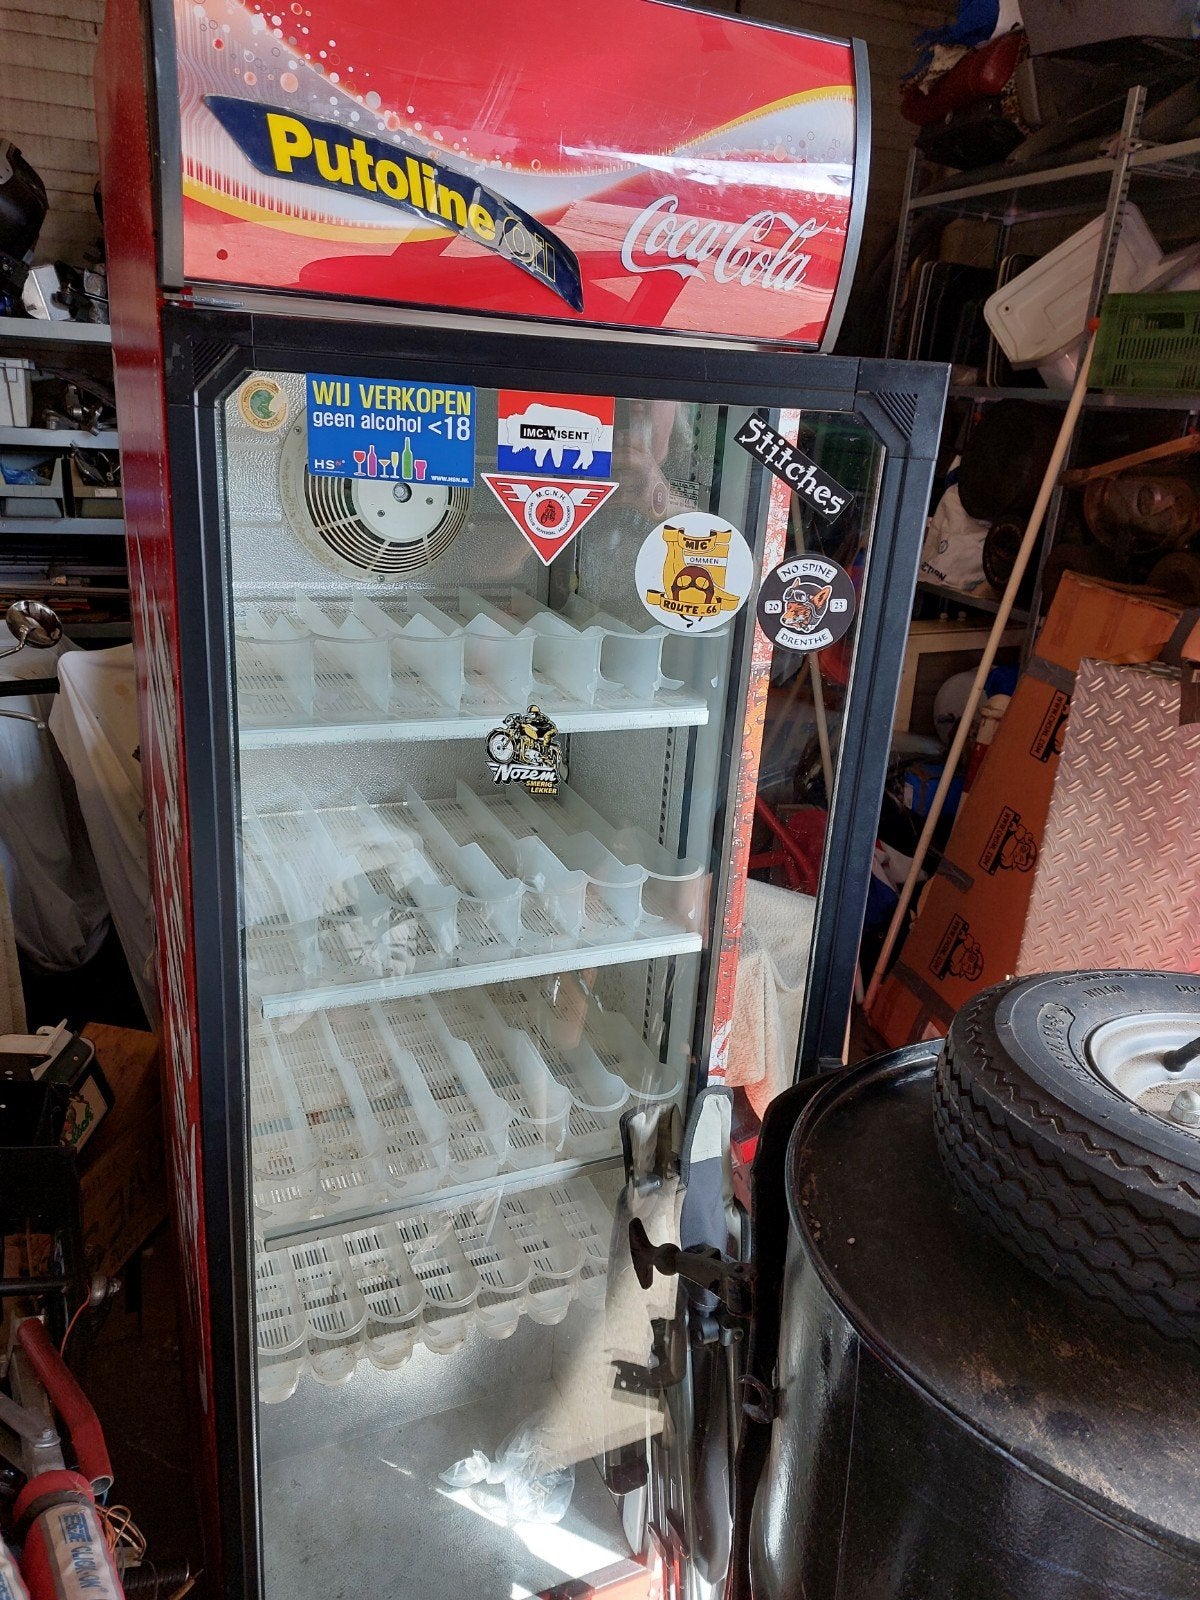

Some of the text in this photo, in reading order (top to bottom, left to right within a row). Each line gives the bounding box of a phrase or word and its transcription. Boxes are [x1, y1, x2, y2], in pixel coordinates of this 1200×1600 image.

[266, 112, 496, 241] Putoline
[312, 380, 350, 407] WIJ
[359, 384, 471, 416] VERKOPEN
[313, 411, 471, 441] geen alcohol <18
[523, 427, 590, 441] IMC-WISENT
[739, 418, 846, 515] Stitches
[684, 538, 712, 550] MTC
[689, 556, 720, 565] OMMEN
[781, 563, 833, 579] NO SPINE
[663, 600, 699, 614] ROUTE
[768, 603, 779, 611] 20
[834, 601, 843, 610] 23
[781, 633, 828, 646] DRENTHE
[492, 763, 557, 782] Nozem
[525, 780, 553, 788] SMERIG
[530, 786, 558, 794] LEKKER
[1175, 984, 1200, 996] DO
